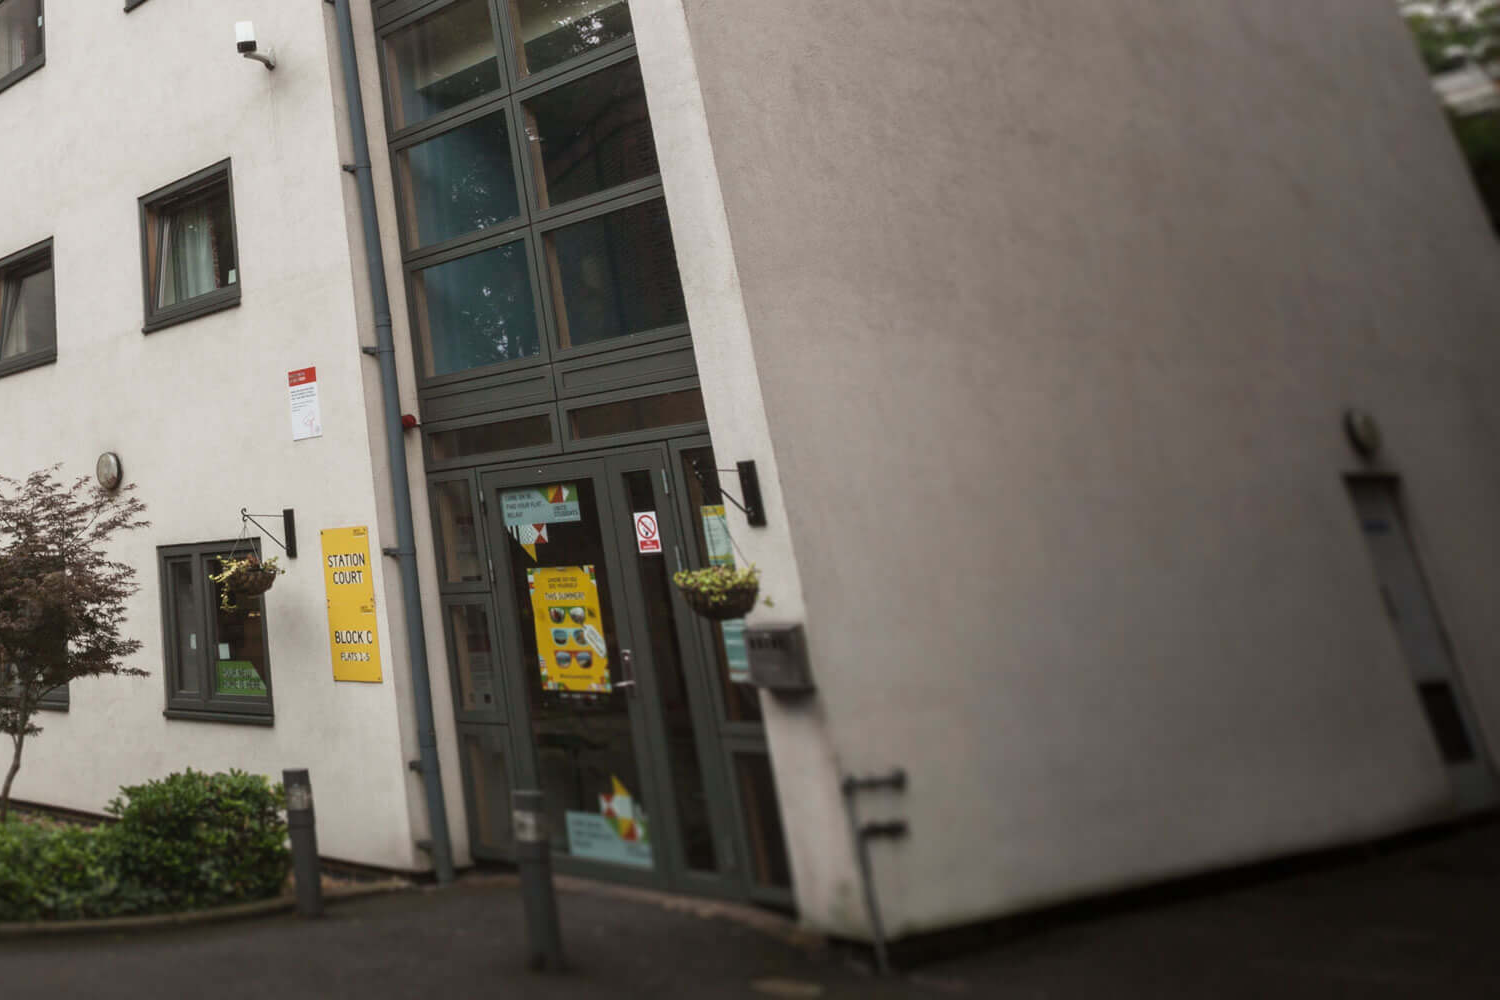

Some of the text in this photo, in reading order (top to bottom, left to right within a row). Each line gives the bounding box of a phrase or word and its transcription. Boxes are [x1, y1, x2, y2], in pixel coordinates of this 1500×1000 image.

[327, 553, 365, 568] STATION
[333, 570, 363, 585] COURT
[334, 630, 373, 644] BLOCK C
[340, 652, 358, 661] FLATS
